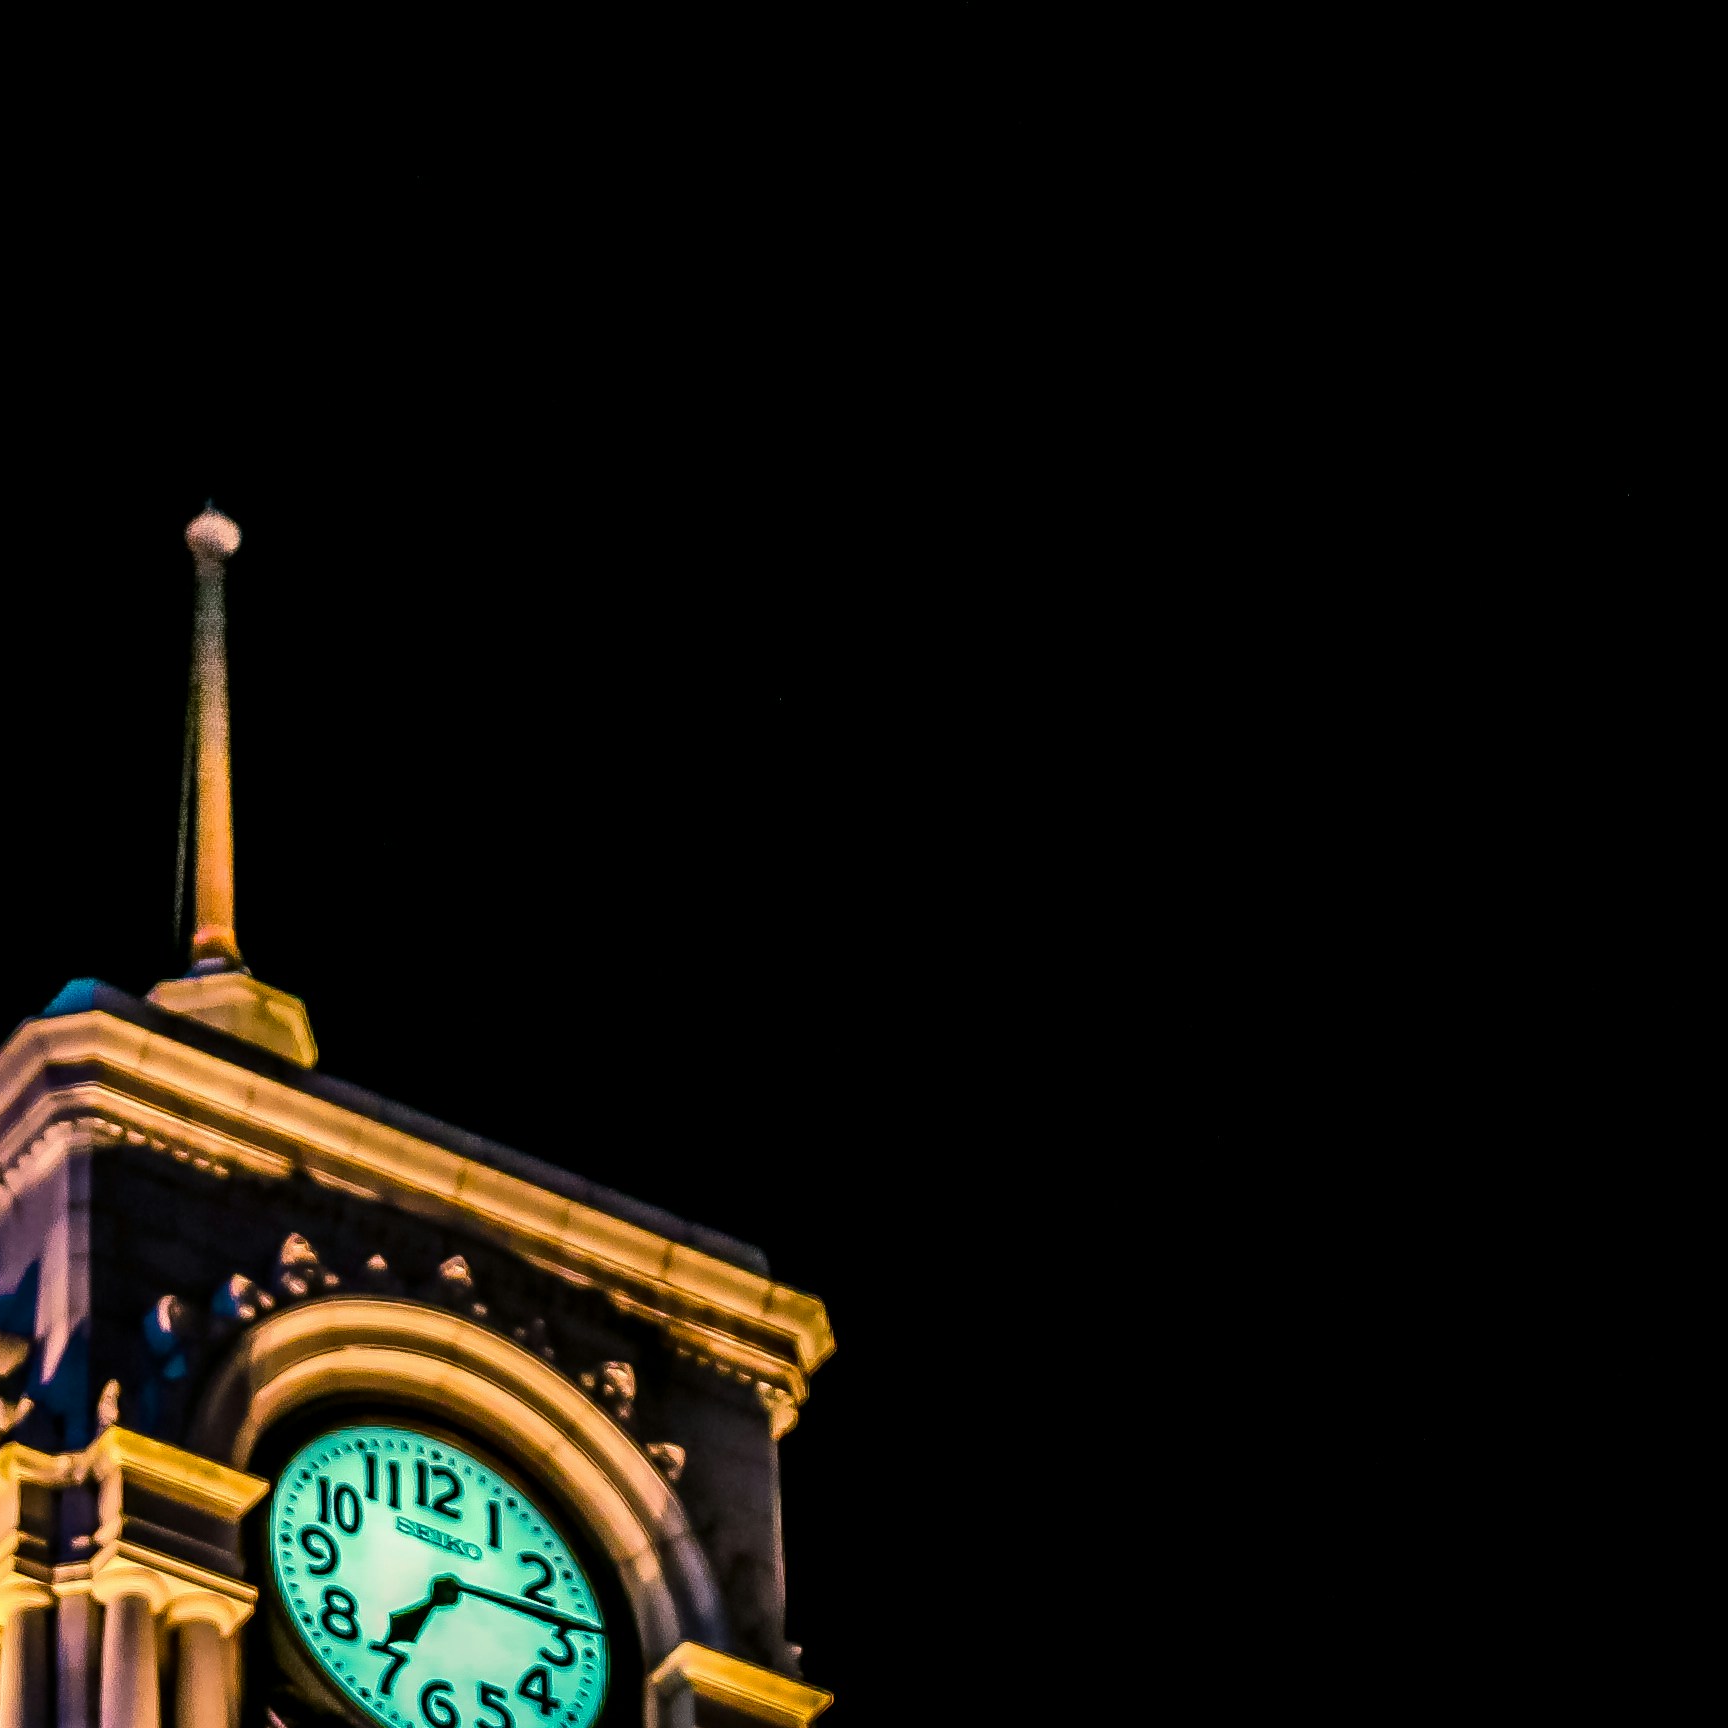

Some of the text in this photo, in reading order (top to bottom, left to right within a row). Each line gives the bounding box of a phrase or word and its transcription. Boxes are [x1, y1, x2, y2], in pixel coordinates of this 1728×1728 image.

[318, 1477, 362, 1534] 10
[364, 1451, 401, 1509] 11
[415, 1459, 463, 1519] 12
[301, 1527, 337, 1575] 9
[396, 1516, 483, 1560] SEIKO
[488, 1500, 502, 1550] 1
[520, 1552, 555, 1605] 2
[321, 1587, 358, 1641] 8
[371, 1641, 410, 1695] 7
[518, 1668, 559, 1716] 4
